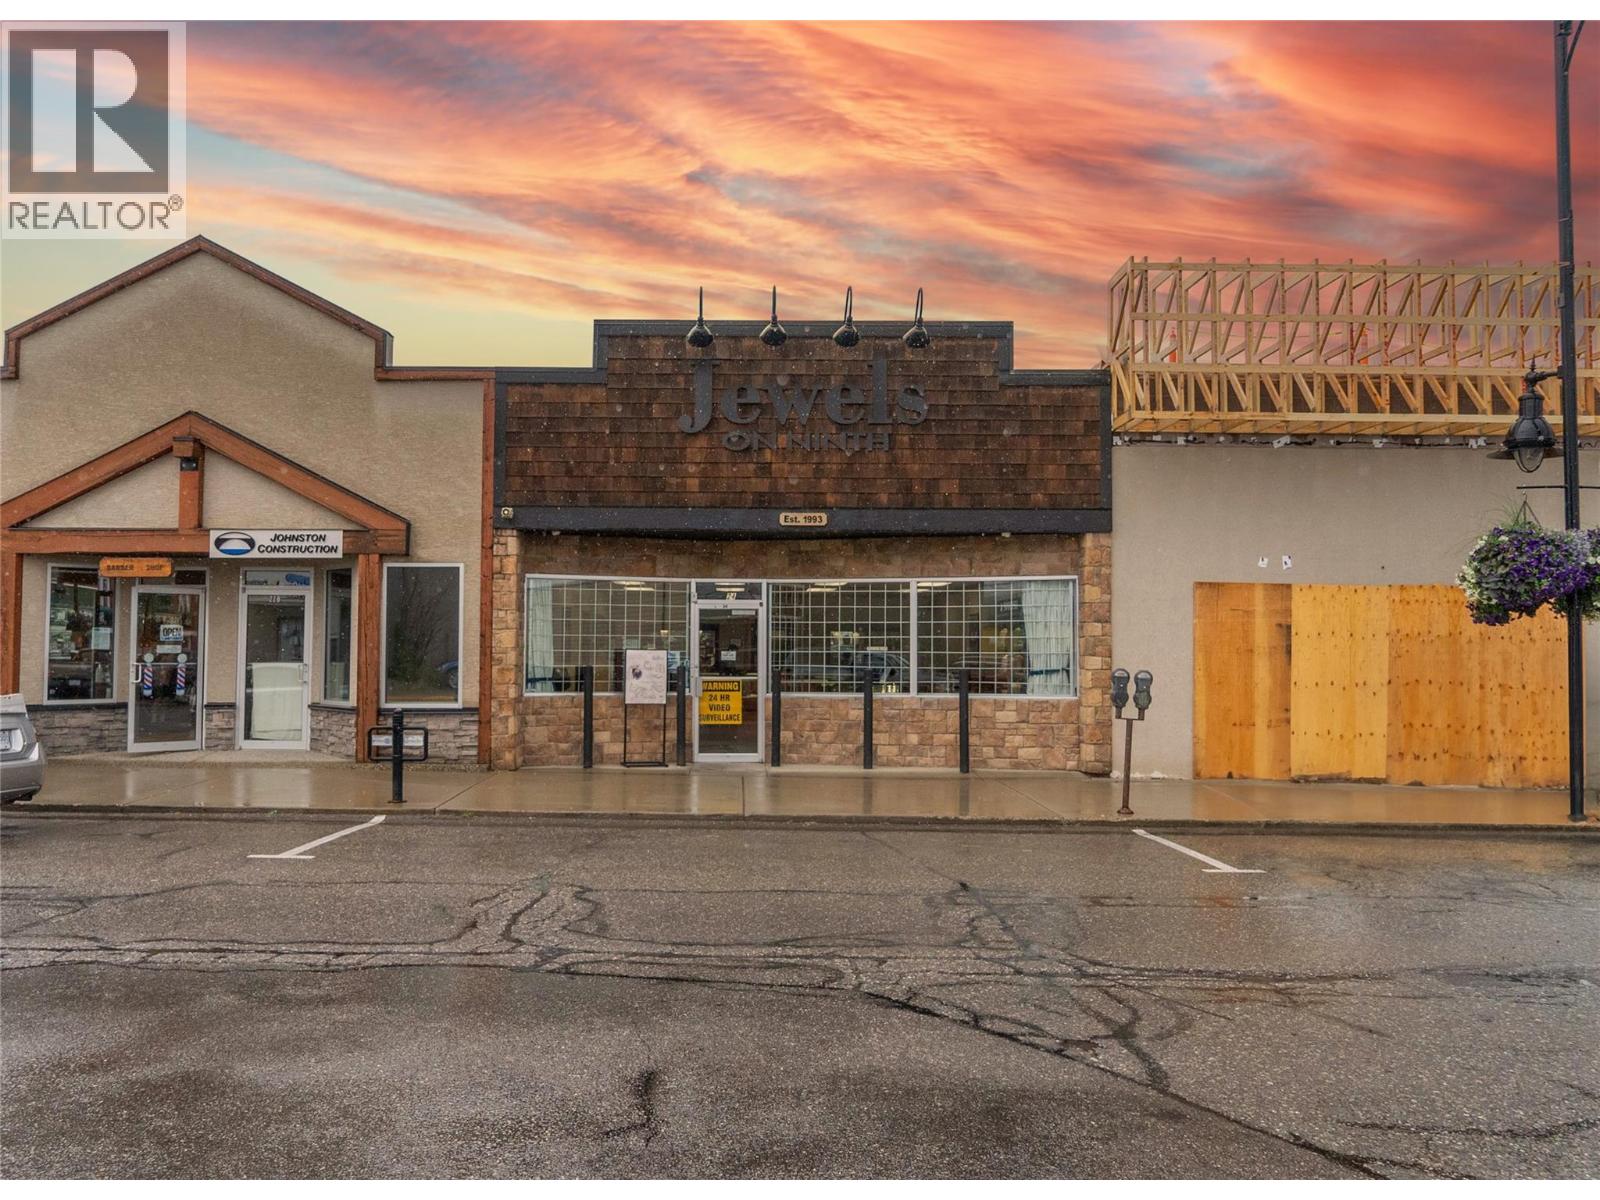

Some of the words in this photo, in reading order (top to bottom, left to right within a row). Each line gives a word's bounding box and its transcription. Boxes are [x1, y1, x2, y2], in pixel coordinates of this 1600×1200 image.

[678, 355, 928, 433] Jewels
[722, 431, 777, 451] ON
[787, 431, 890, 452] NINTH
[784, 515, 800, 523] Est.
[803, 515, 823, 523] 1993
[270, 533, 327, 543] JOHNSTON
[257, 544, 338, 554] CONSTRUCTION
[162, 627, 182, 637] OPEN
[701, 682, 739, 691] WARNING
[708, 704, 731, 712] VIDEO
